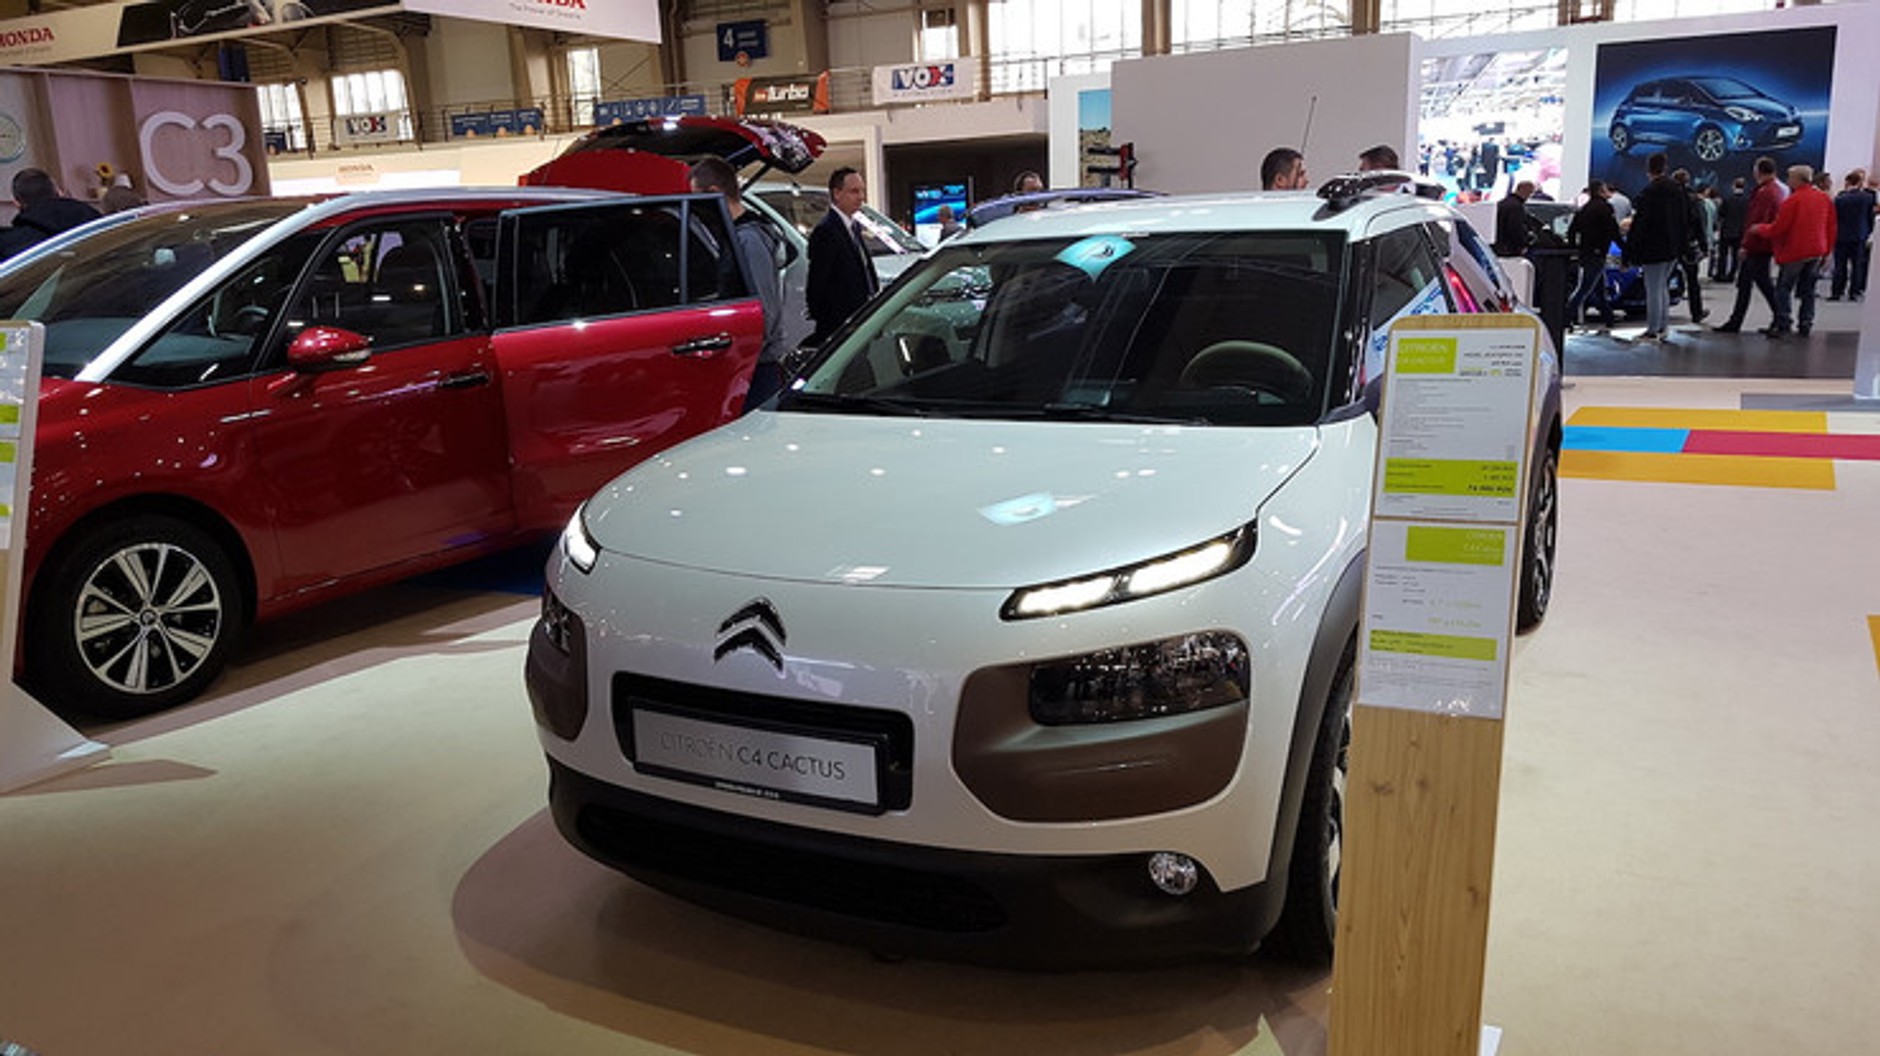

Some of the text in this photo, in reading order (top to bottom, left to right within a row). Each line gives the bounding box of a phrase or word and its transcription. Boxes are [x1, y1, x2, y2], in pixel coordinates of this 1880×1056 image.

[723, 28, 735, 48] 4
[140, 111, 253, 197] C3
[736, 746, 762, 766] C4
[766, 751, 845, 780] CACTUS
